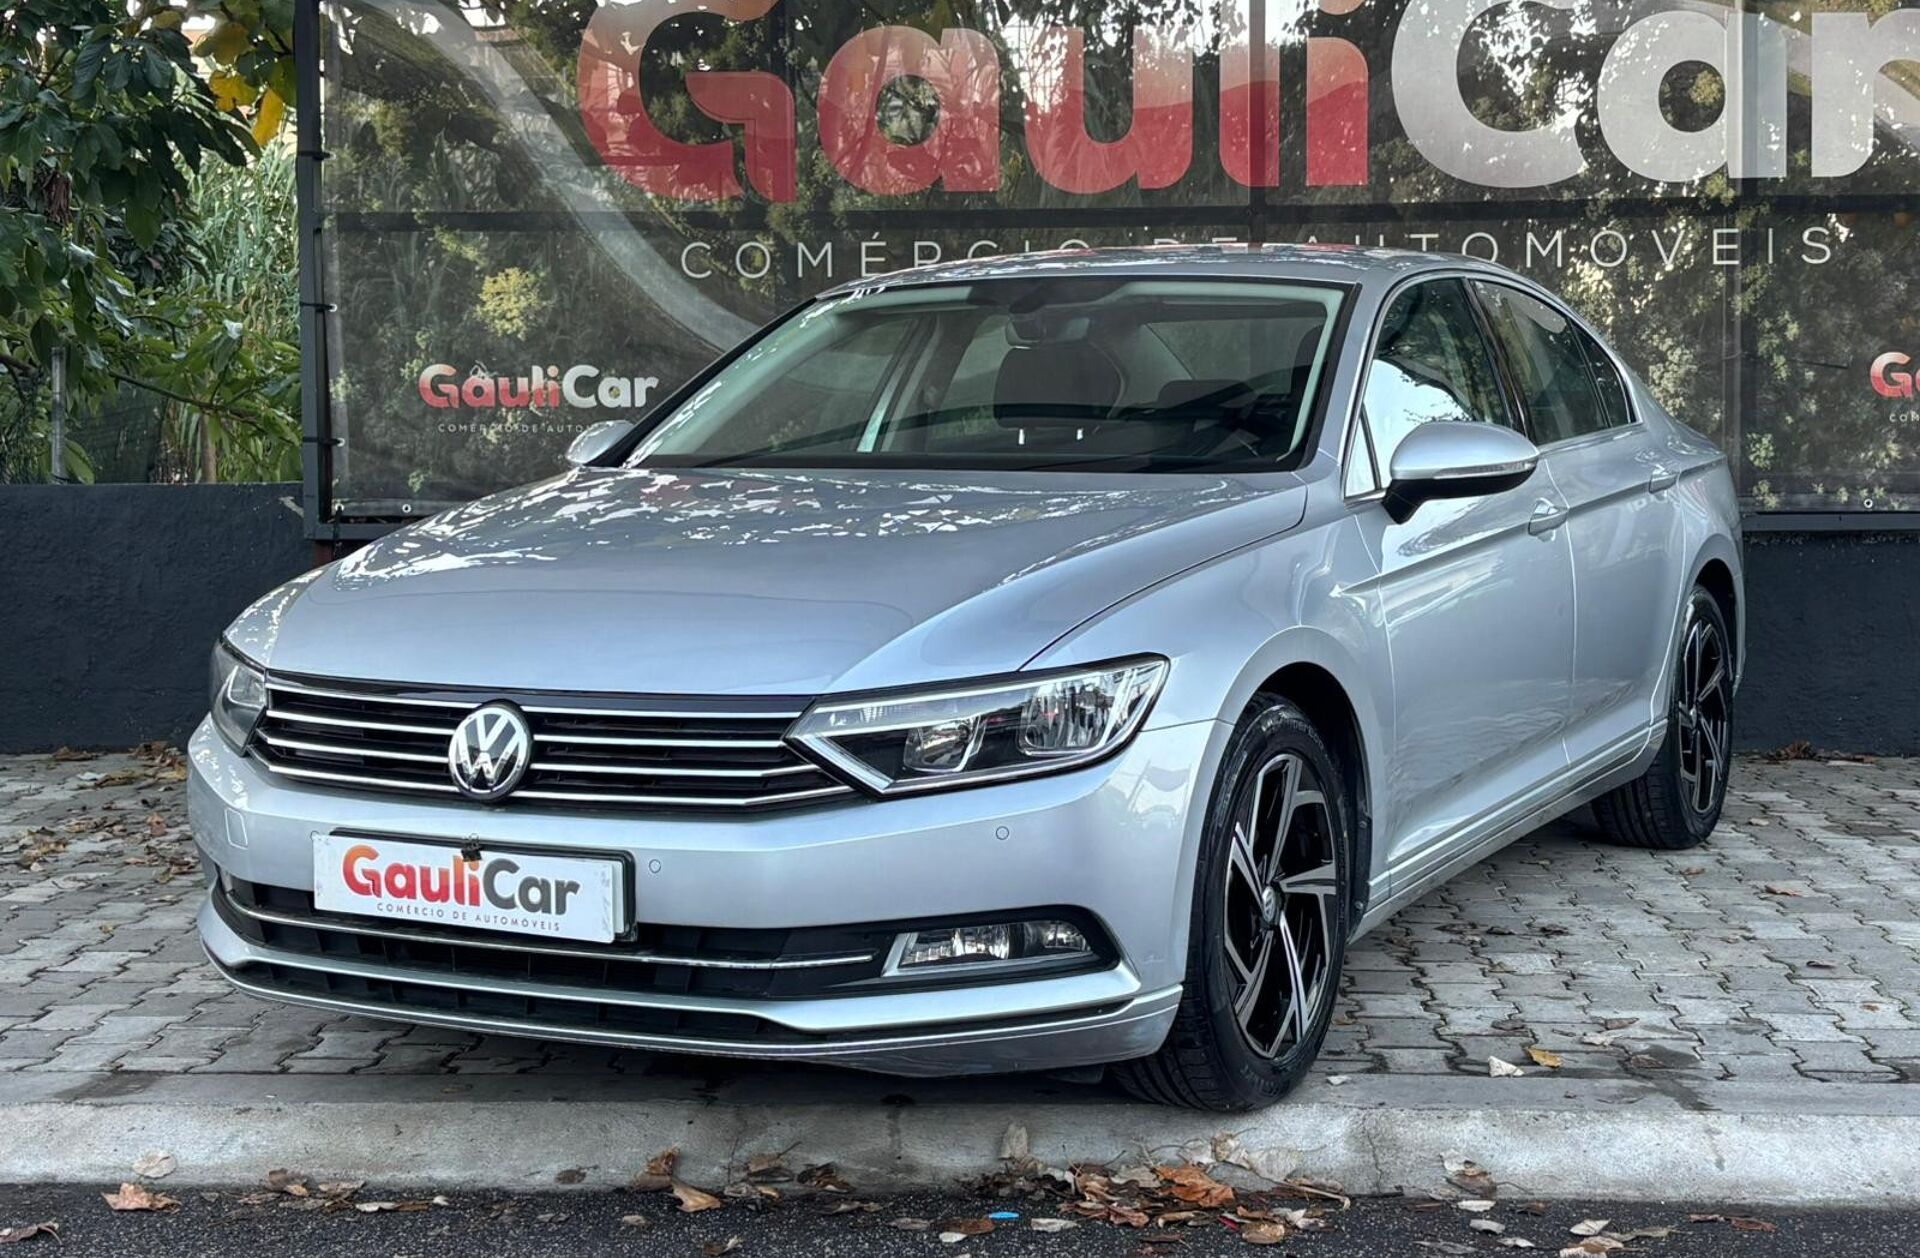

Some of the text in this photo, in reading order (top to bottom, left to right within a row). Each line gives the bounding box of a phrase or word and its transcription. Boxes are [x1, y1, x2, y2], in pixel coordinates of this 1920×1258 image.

[577, 0, 1920, 201] GauliCar
[419, 363, 659, 409] GauliCar
[521, 423, 538, 433] DE
[342, 844, 580, 916] GauliCar
[453, 911, 467, 921] DE
